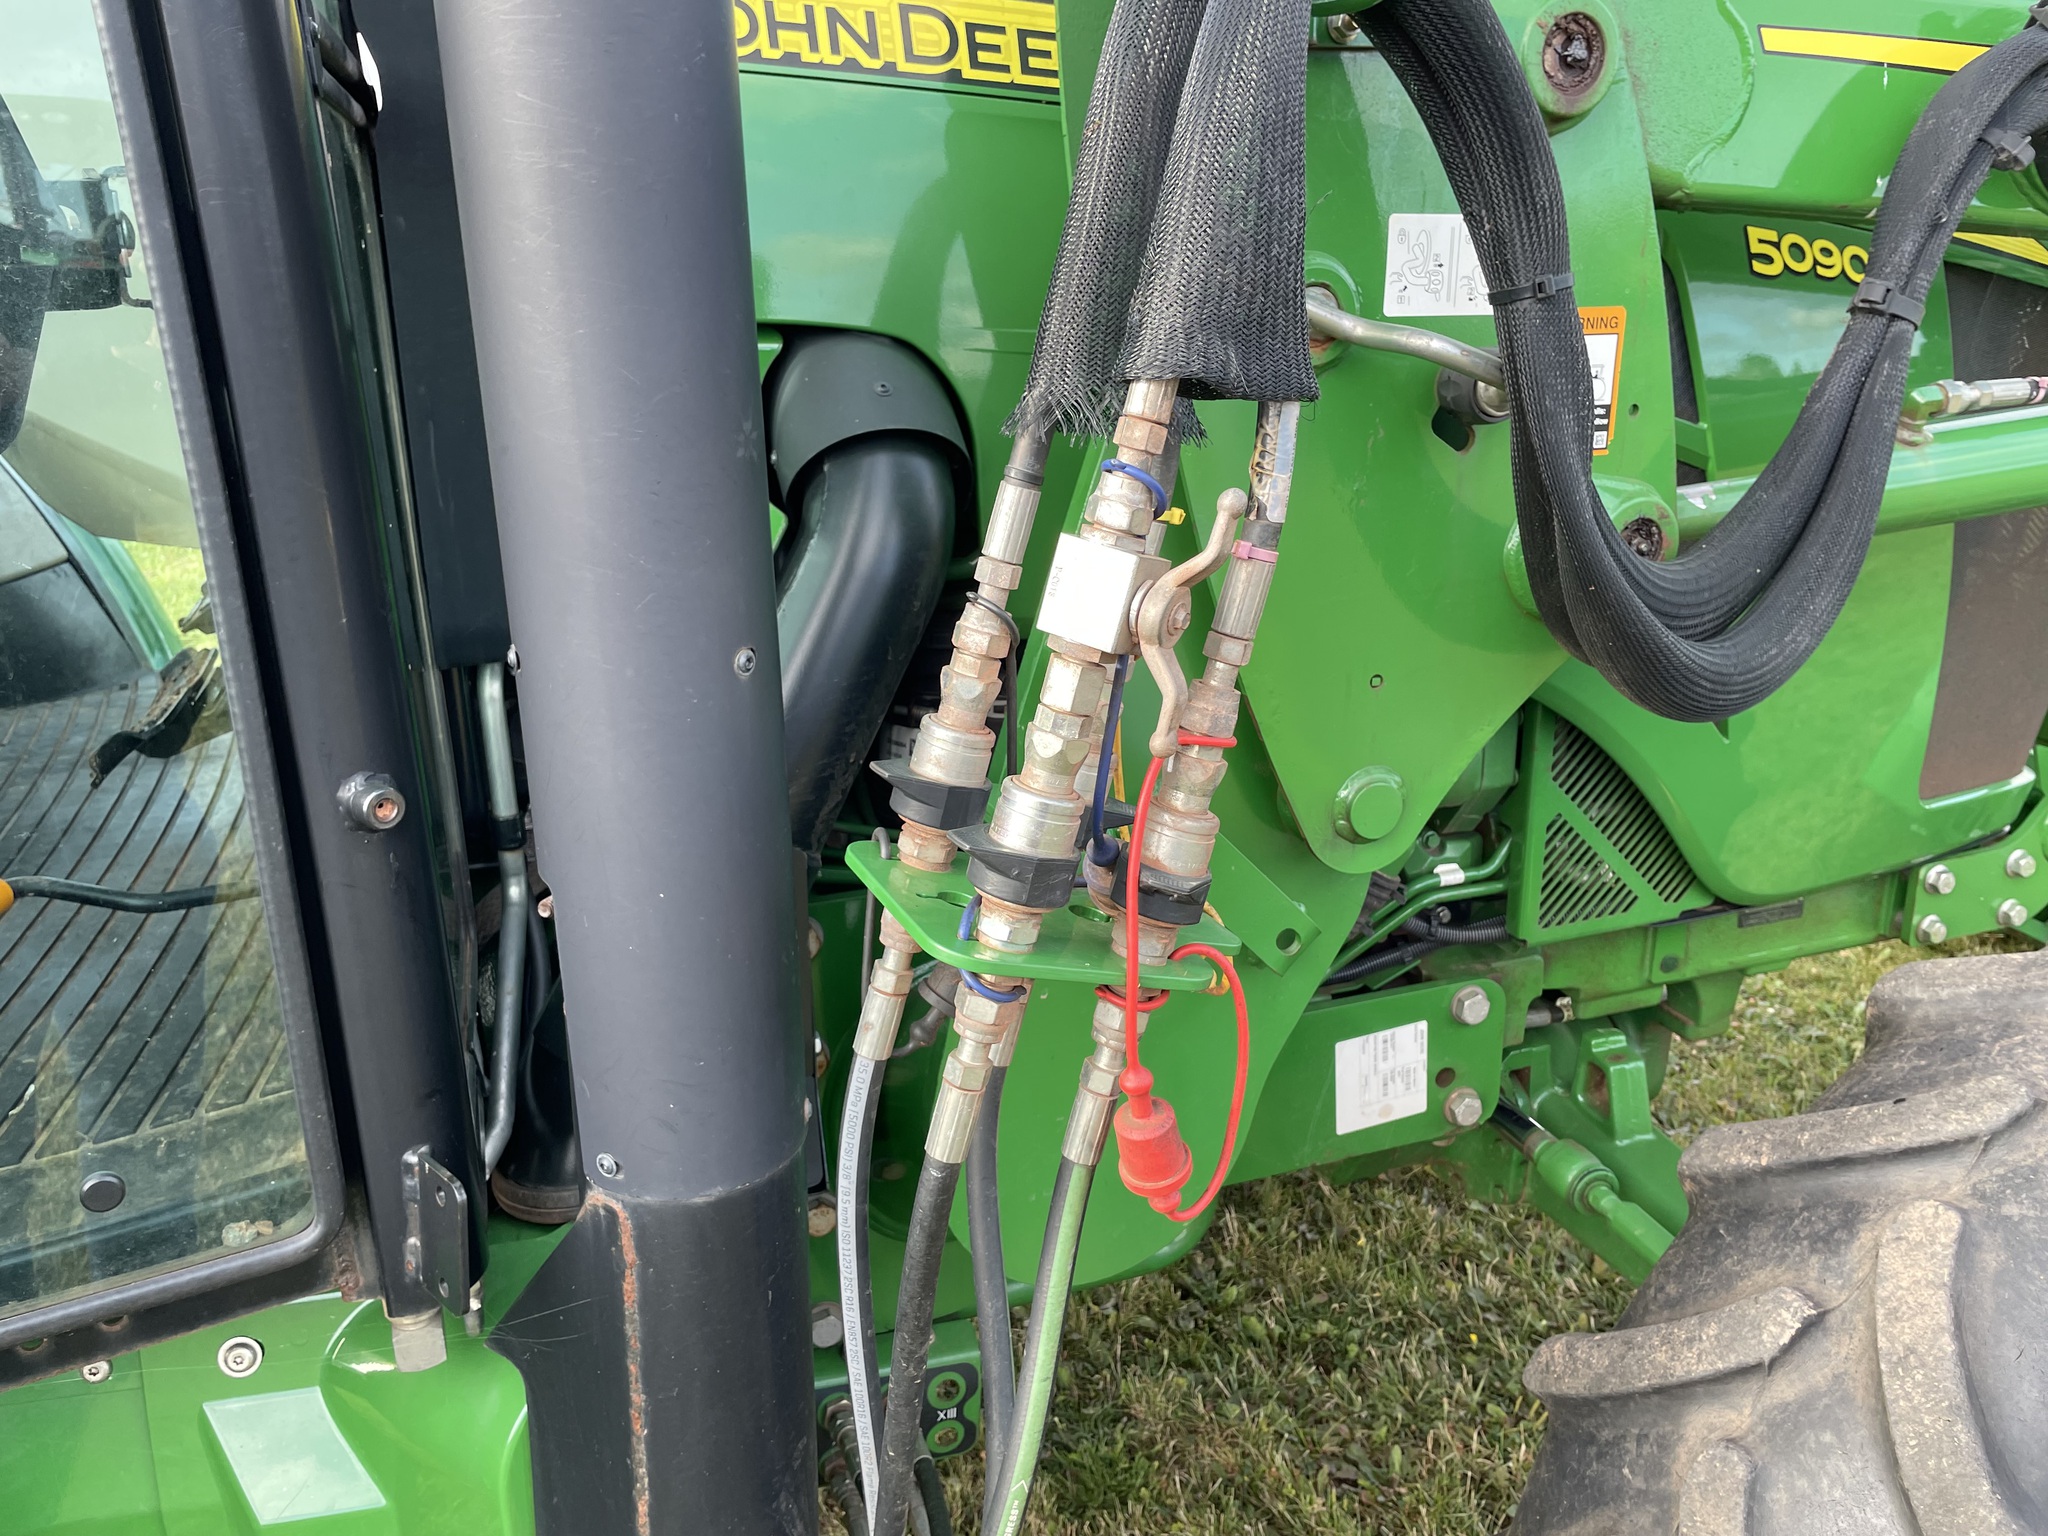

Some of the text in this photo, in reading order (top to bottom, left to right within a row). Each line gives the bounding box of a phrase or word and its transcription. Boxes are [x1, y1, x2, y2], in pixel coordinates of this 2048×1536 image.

[735, 0, 1058, 80] OHN DEE
[1746, 225, 1869, 284] 5090
[1580, 316, 1618, 329] NING
[856, 1061, 869, 1084] 35.0
[851, 1085, 863, 1107] MPa
[846, 1109, 859, 1140] (5000
[842, 1142, 854, 1161] PSI)
[841, 1164, 852, 1184] 3/8"
[840, 1206, 850, 1228] mm)
[841, 1231, 851, 1245] ISO
[842, 1247, 852, 1275] 11237
[843, 1277, 853, 1294] 2SC
[845, 1296, 854, 1313] R16
[846, 1320, 858, 1347] EN857
[849, 1348, 859, 1365] 2SC
[852, 1372, 862, 1387] SAE
[854, 1390, 867, 1418] 100R16
[936, 1407, 957, 1422] XIII
[860, 1425, 870, 1439] SAE
